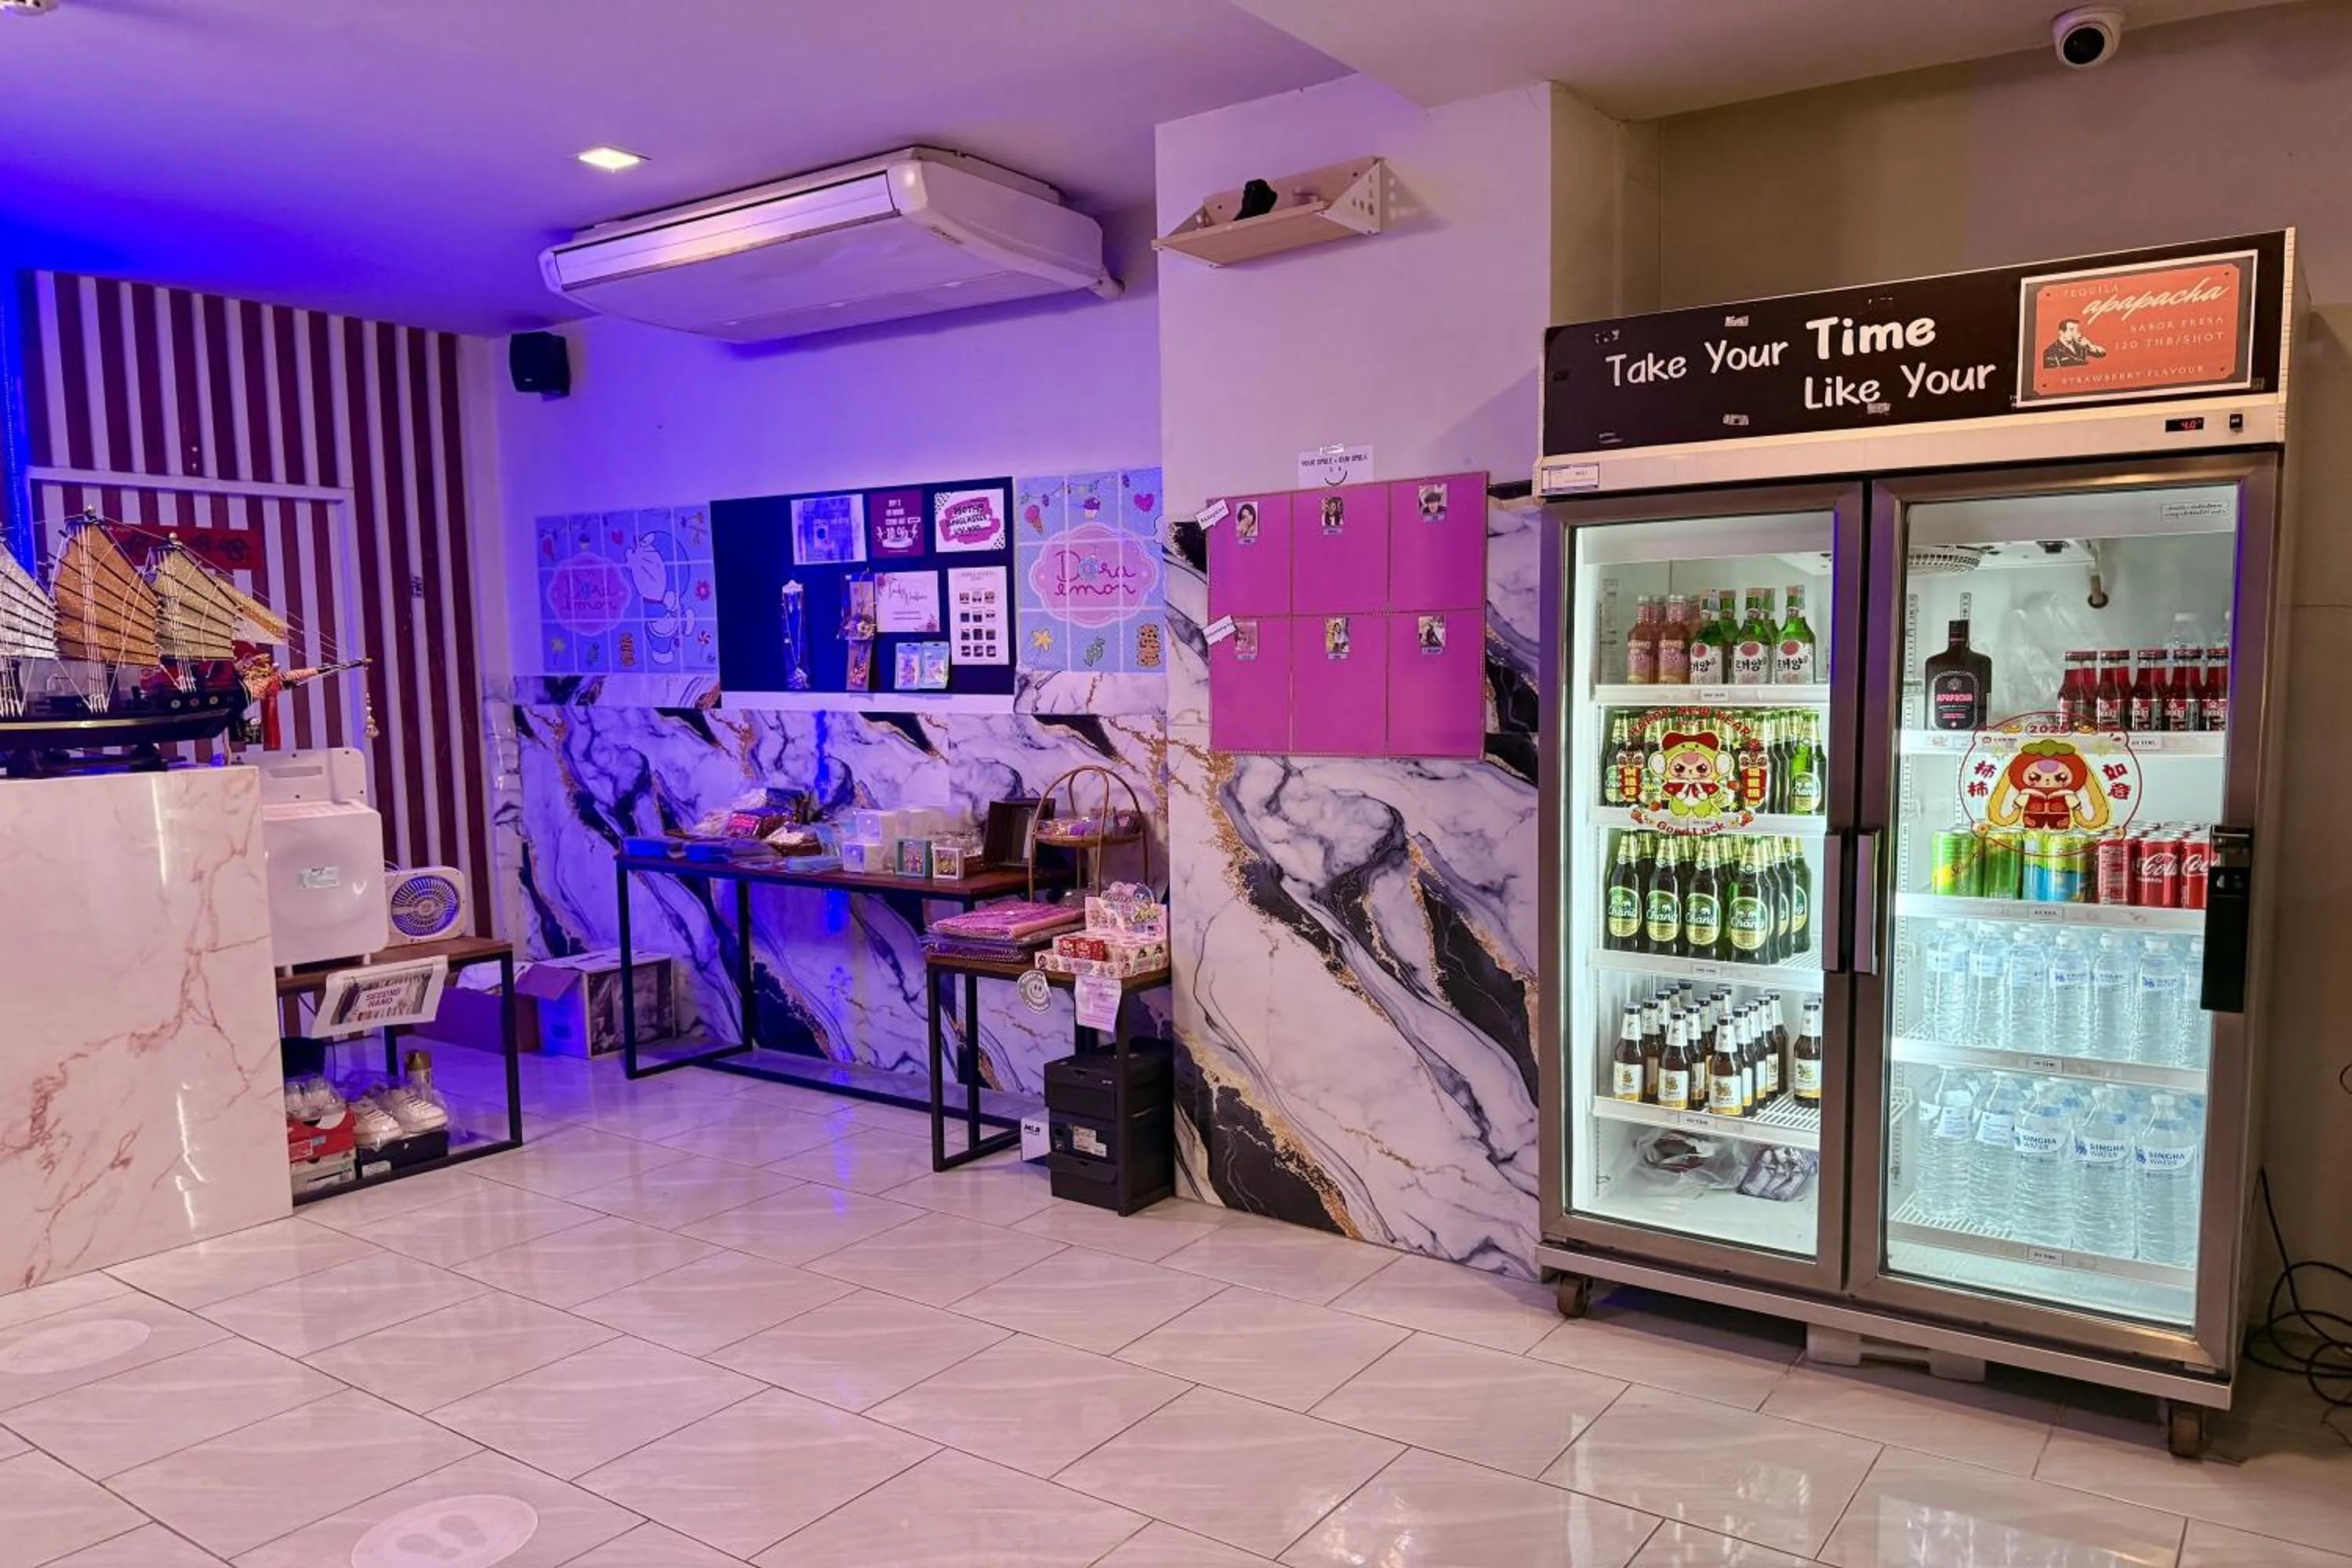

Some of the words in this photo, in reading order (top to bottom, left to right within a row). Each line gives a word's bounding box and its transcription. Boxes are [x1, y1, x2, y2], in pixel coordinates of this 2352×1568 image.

[2063, 285, 2120, 298] TEQUILA
[2082, 277, 2230, 325] apapacha
[2146, 331, 2225, 348] THB/SHOT
[1606, 353, 1687, 387] Take
[1704, 339, 1788, 374] Your
[1806, 316, 1936, 360] Time
[1804, 376, 1881, 410] Like
[1900, 362, 1997, 398] Your
[2060, 370, 2142, 387] STRAWBERRY
[2147, 365, 2205, 378] FLAVOUR
[2147, 1151, 2186, 1160] SINGHA
